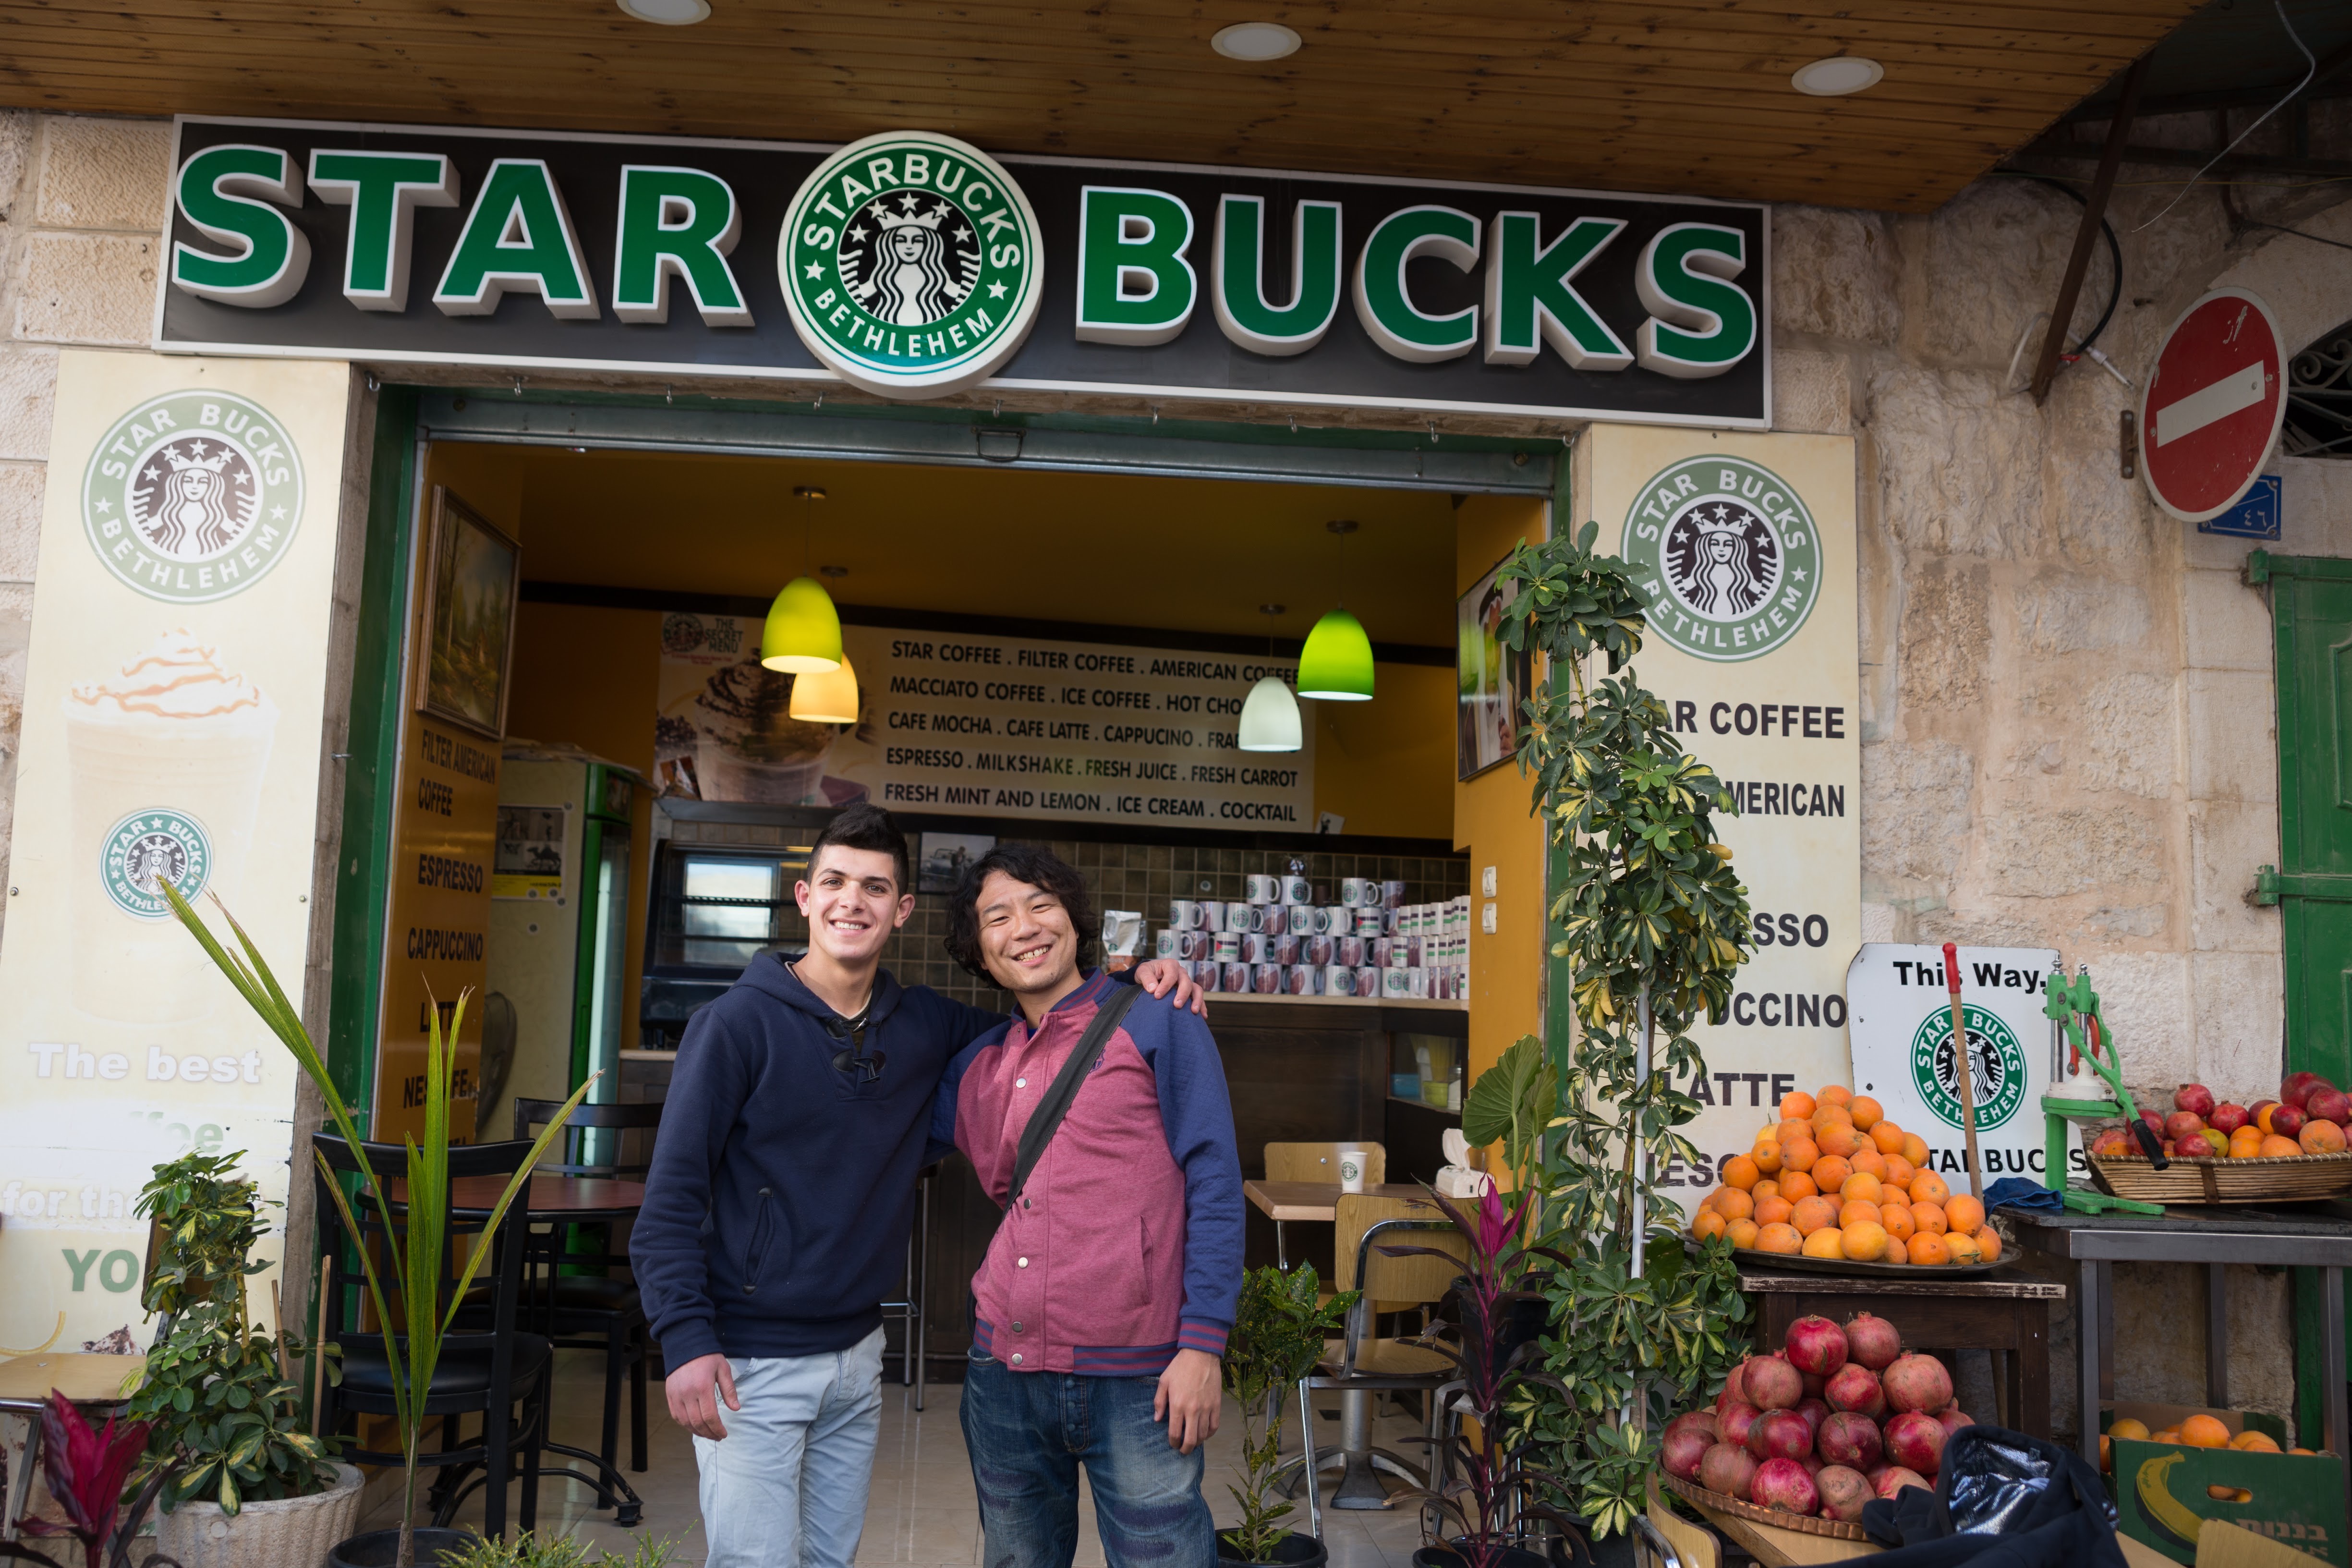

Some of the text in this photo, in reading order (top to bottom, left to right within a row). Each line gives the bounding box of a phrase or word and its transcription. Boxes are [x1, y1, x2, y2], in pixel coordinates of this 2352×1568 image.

[803, 153, 1021, 269] STARBUCKS
[172, 143, 1758, 379] STAR BUCKS
[814, 287, 994, 357] BETHLEHEM
[101, 403, 290, 486] STAR BUCKS
[1637, 469, 1807, 550] STAR BUCKS
[101, 517, 280, 590] BETHLEHEM
[715, 618, 735, 631] THE
[1642, 578, 1803, 648] BETHLEHEM
[705, 628, 743, 642] SECRET
[708, 638, 739, 654] MENU
[892, 640, 933, 660] STAR
[939, 644, 1002, 665] COFFEE
[1018, 650, 1068, 669] FILTER
[1074, 653, 1135, 674] COFFEE
[1150, 659, 1237, 681] AMERICAN
[890, 676, 979, 699] MACCIATO
[985, 682, 1045, 703] COFFEE
[1061, 687, 1086, 705] ICE
[1092, 689, 1151, 710] COFFEE
[1166, 694, 1201, 712] HOT
[888, 711, 927, 730] CAFE
[932, 715, 992, 735] MOCHA
[1006, 719, 1044, 738] CAFE
[1050, 722, 1090, 741] LATTE
[1104, 725, 1193, 747] CAPPUCINO
[1710, 701, 1845, 739] COFFEE
[421, 729, 496, 786] FILTER AMERICAN
[886, 747, 1298, 788] ESPRESSO MILKSHAKE FRESH JUICE FRESH CARROT
[418, 777, 453, 817] COFFEE
[885, 783, 1297, 823] FRESH MINT AND LEMON ICE CREAM COCKTAIL
[109, 820, 203, 874] STAR BUCKS
[417, 853, 483, 894] ESPRESSO
[407, 927, 484, 961] CAPPUCCINO
[1917, 1012, 2021, 1072] STAR BUCKS
[29, 1042, 261, 1084] The best
[1923, 1080, 2019, 1124] BETHEHEM
[2, 1180, 68, 1217] for
